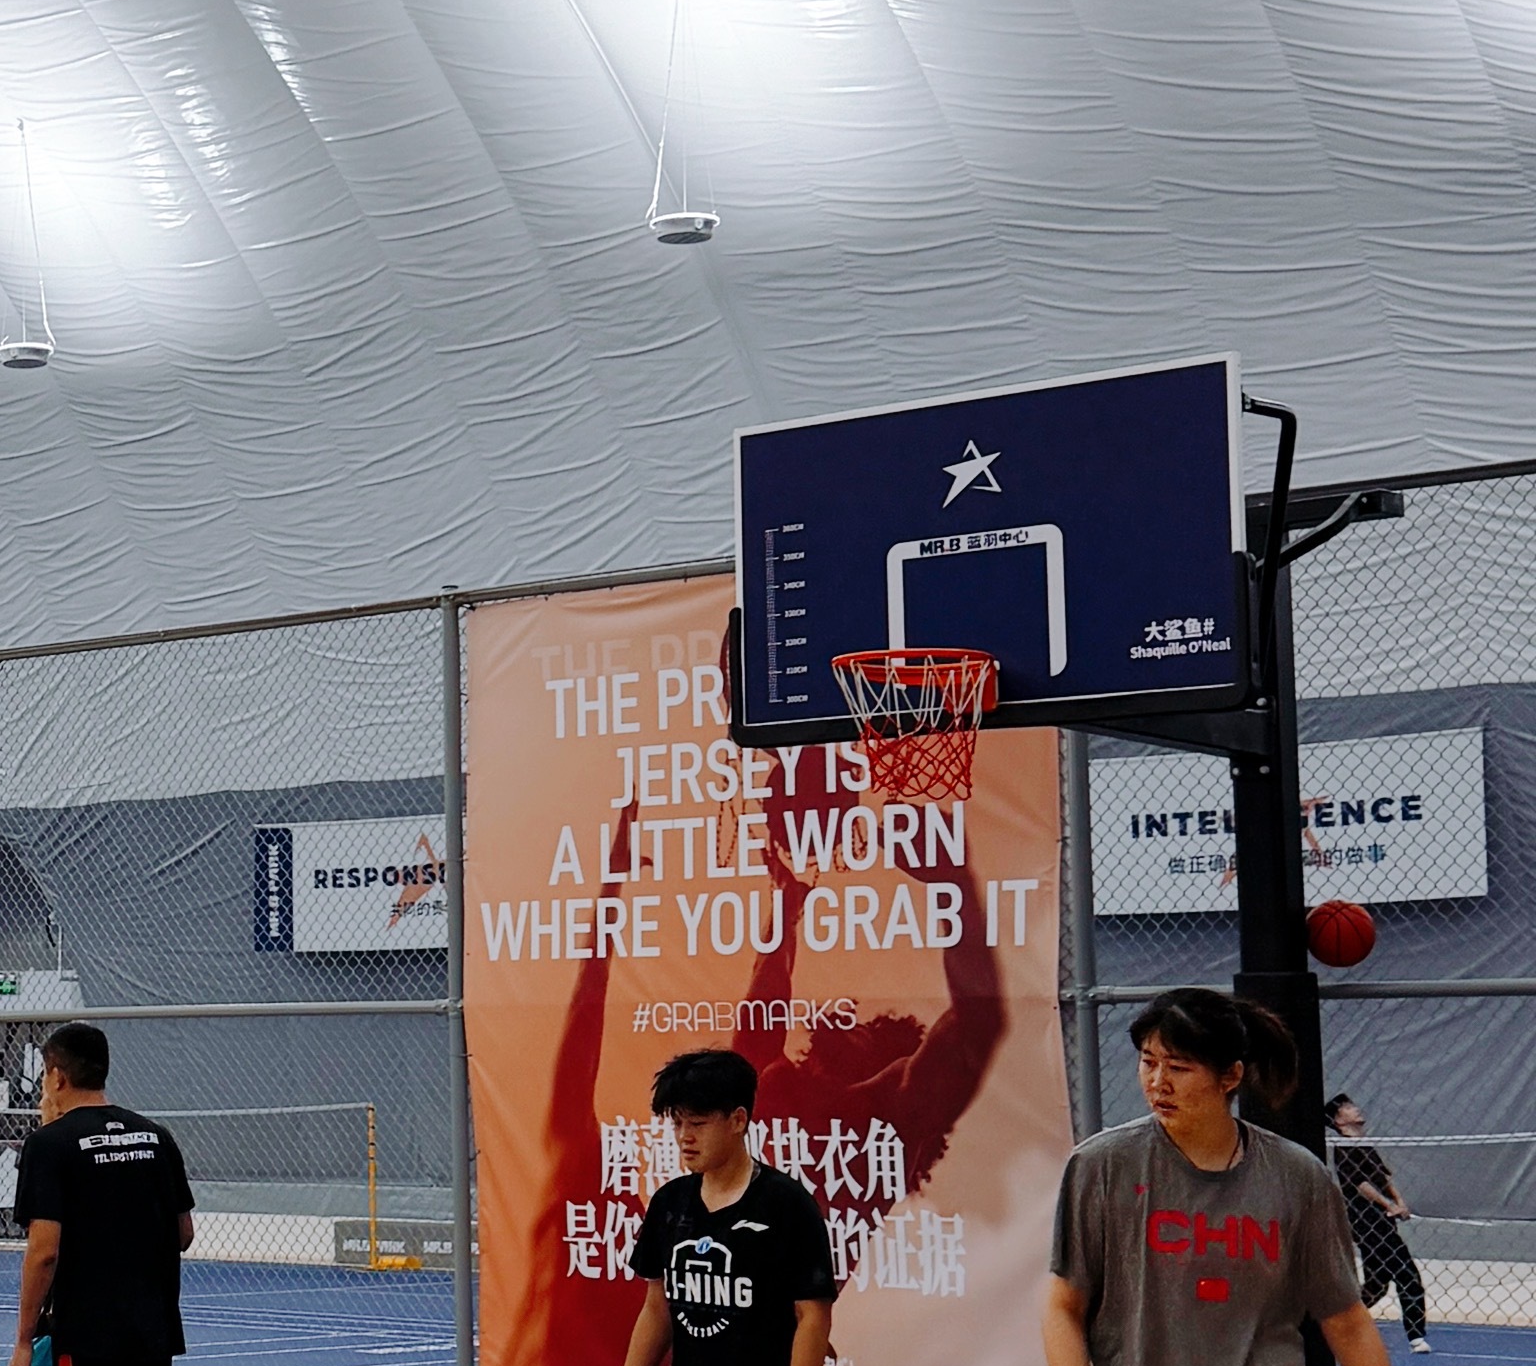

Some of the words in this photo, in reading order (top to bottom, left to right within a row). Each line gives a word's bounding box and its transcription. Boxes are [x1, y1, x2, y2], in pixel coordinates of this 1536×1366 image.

[1130, 641, 1187, 660] Shaquille
[1188, 636, 1231, 654] O'Neal
[1144, 617, 1215, 643] 大鲨鱼#
[545, 671, 640, 738] THE
[610, 742, 812, 809] JERSEY
[824, 741, 873, 794] IS
[1131, 795, 1422, 839] INTELENCE
[549, 825, 584, 886] A
[600, 812, 769, 884] LITTLE
[783, 801, 966, 875] WORN
[314, 862, 446, 889] RESPONSI
[481, 895, 661, 962] WHERE
[675, 889, 784, 956] YOU
[803, 882, 964, 953] GRAB
[985, 878, 1039, 947] IT
[632, 997, 858, 1034] #GRABMARKS
[1147, 1210, 1280, 1263] CHN
[664, 1268, 753, 1308] LI-NING
